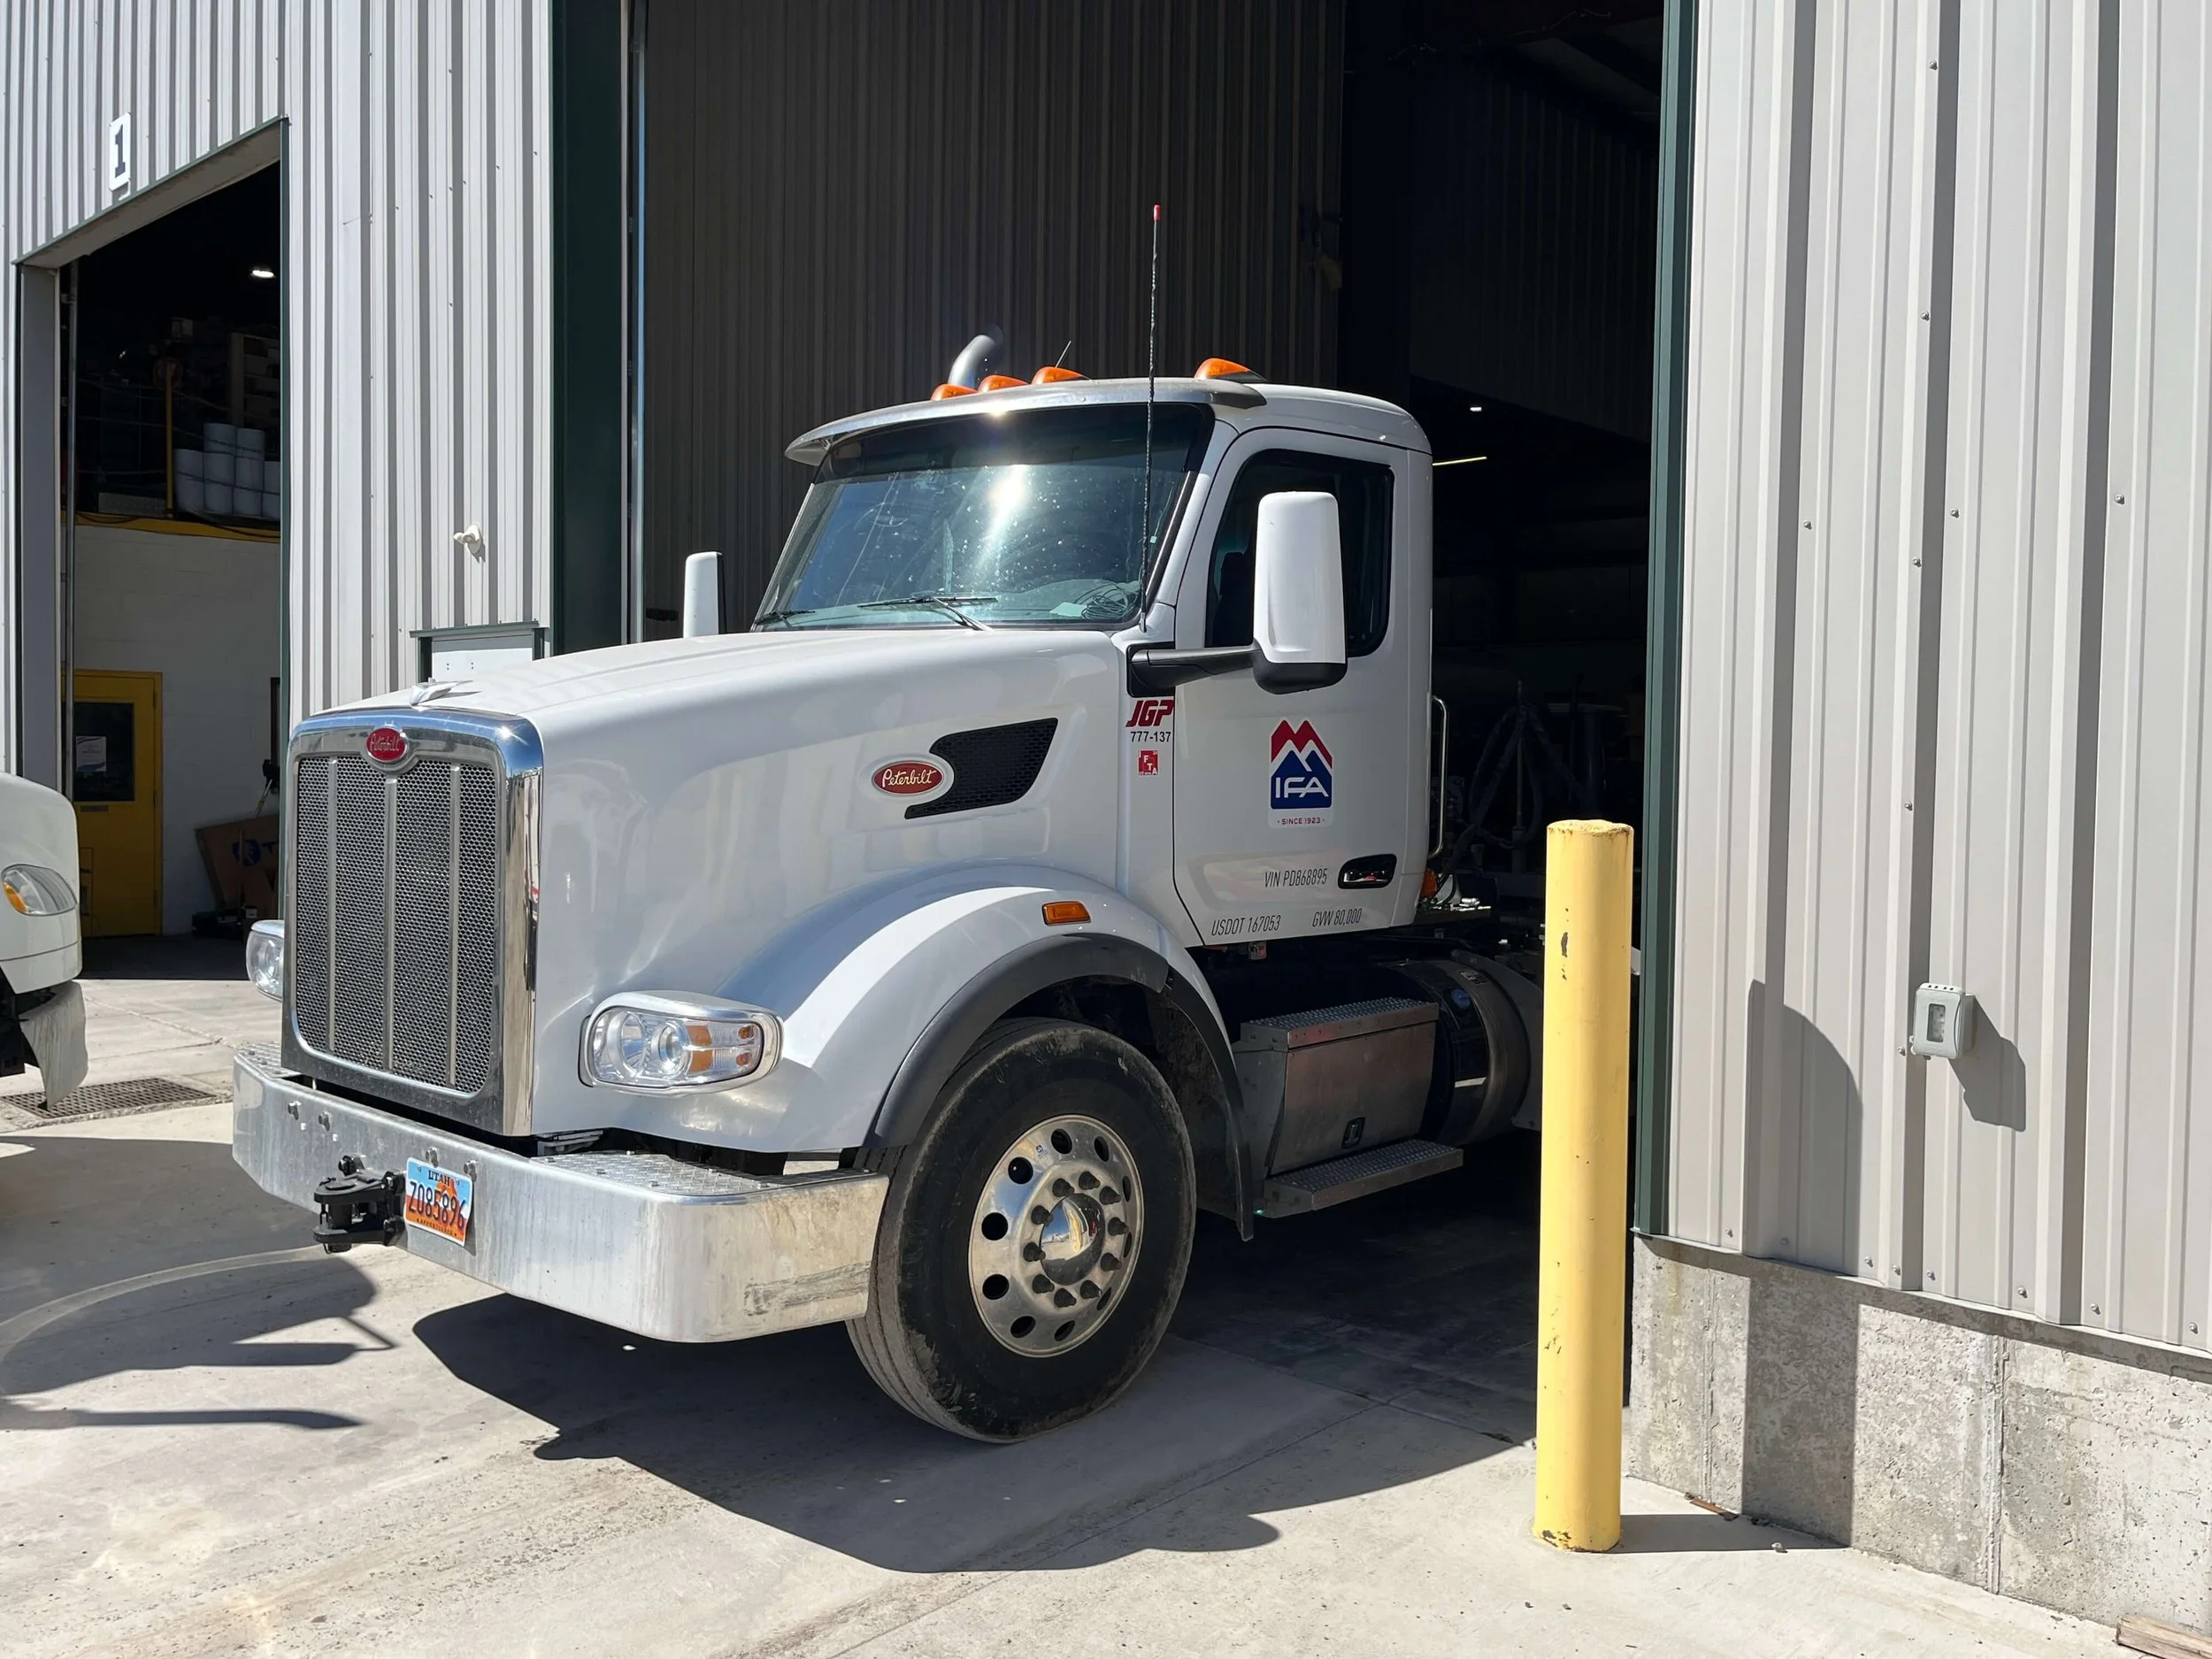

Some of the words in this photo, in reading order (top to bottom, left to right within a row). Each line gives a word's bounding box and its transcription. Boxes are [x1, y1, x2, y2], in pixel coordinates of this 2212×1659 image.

[115, 124, 126, 178] 1
[1125, 700, 1174, 727] JGP
[1131, 731, 1171, 742] 777-137
[882, 768, 938, 787] Peterbilt
[1275, 777, 1329, 798] IFA
[1264, 871, 1281, 887] VIN
[1283, 868, 1328, 887] PD868895
[1211, 918, 1246, 936] USDOT
[1248, 914, 1282, 933] 167053
[1312, 911, 1334, 927] GVW
[1333, 908, 1363, 926] 80,000
[428, 1170, 451, 1187] UTAH
